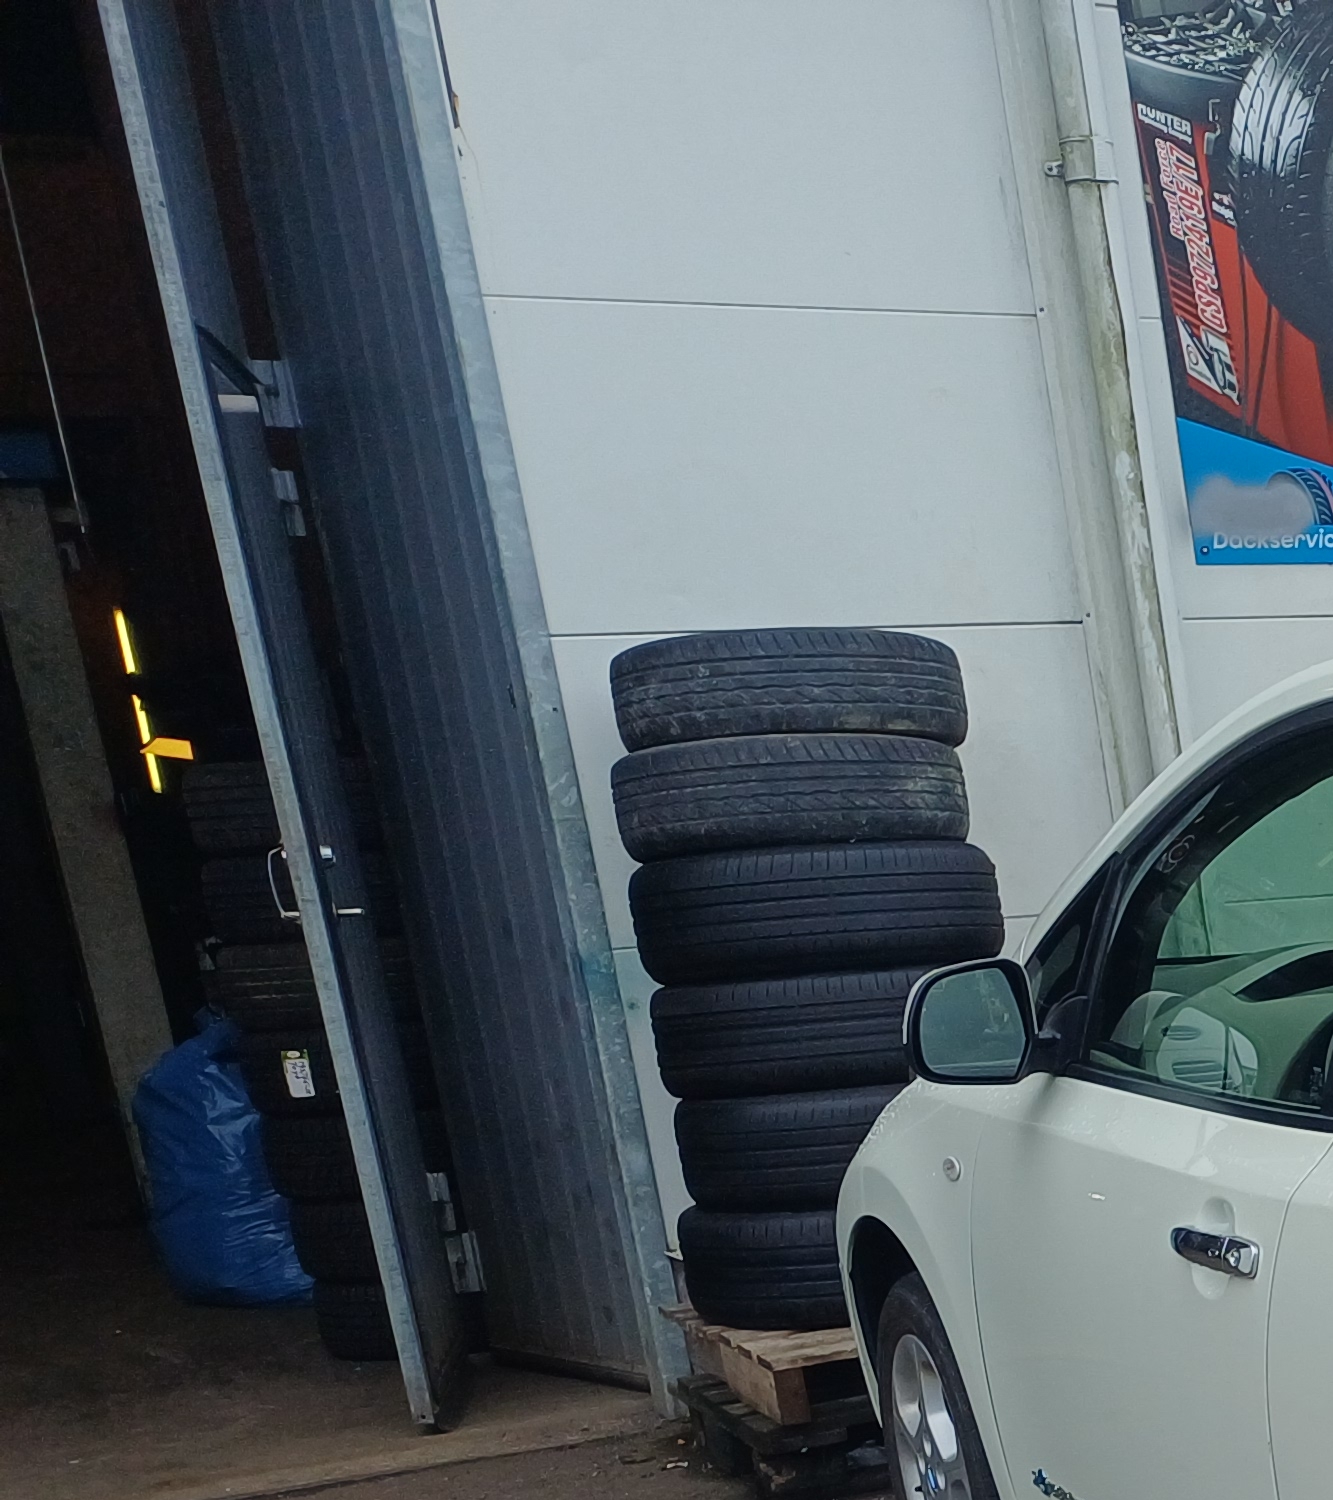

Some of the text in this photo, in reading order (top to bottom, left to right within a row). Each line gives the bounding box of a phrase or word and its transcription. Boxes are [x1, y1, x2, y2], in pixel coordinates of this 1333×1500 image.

[1137, 103, 1192, 139] HUNTER
[1155, 138, 1185, 240] Road Force
